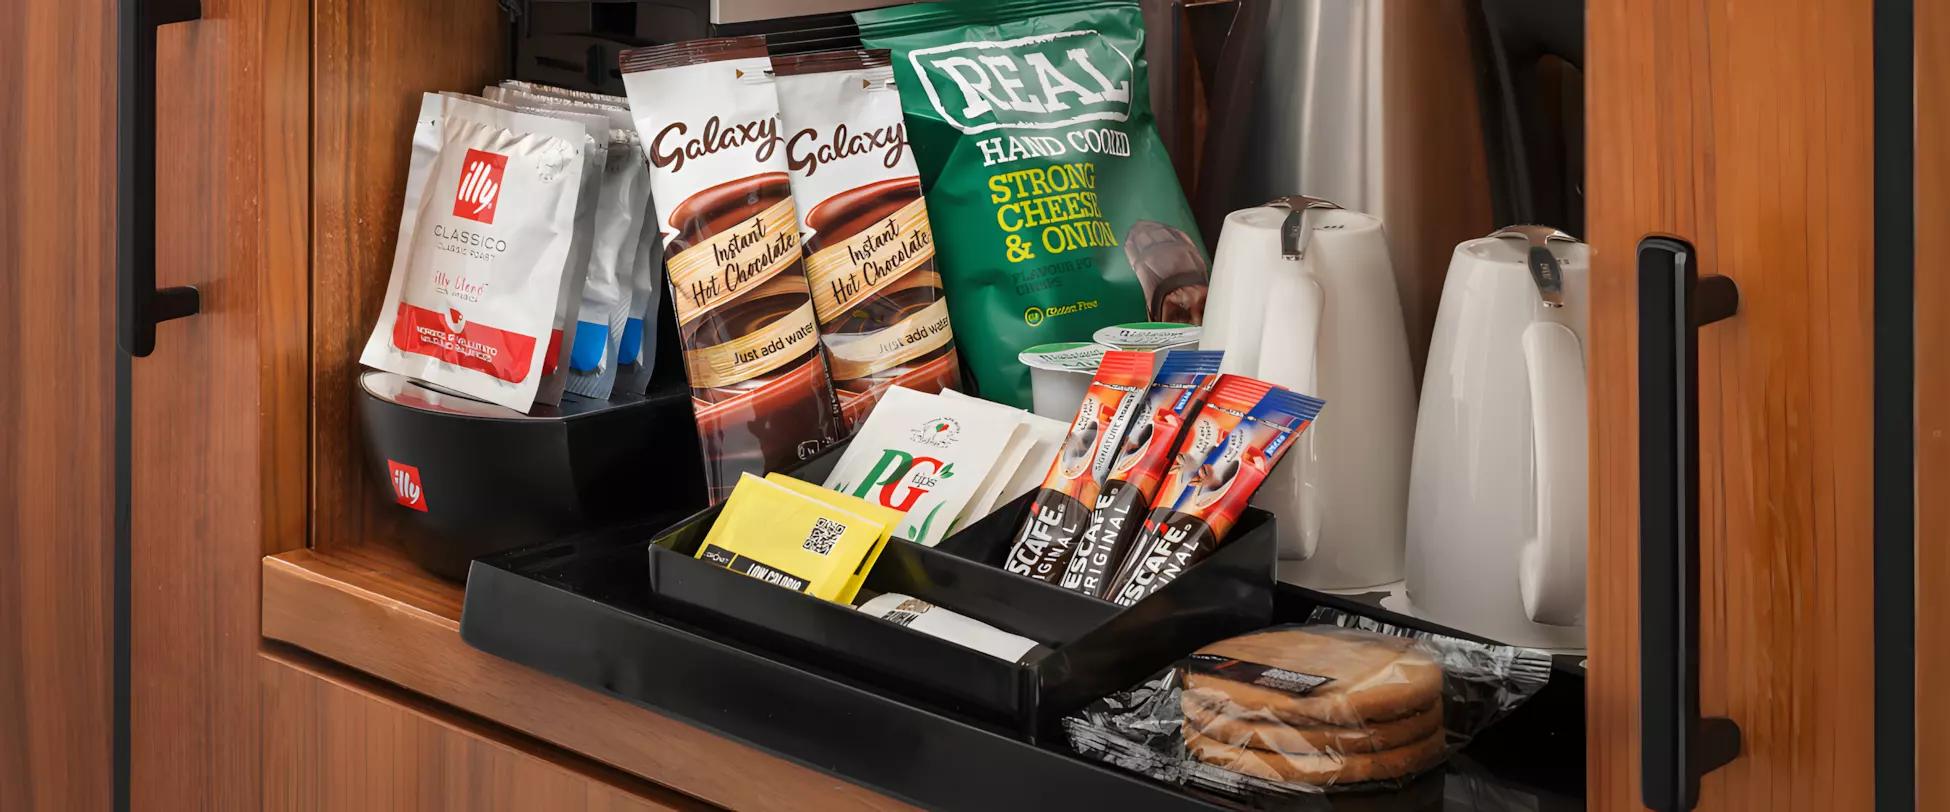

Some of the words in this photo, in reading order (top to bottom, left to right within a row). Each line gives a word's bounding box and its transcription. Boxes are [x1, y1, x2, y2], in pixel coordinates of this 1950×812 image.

[931, 48, 1129, 119] REAL
[650, 115, 785, 173] Galaxy
[786, 123, 910, 177] Galaxy
[976, 136, 1067, 167] HAND
[458, 161, 498, 214] illy
[988, 163, 1096, 204] STRONG
[997, 191, 1102, 232] CHEESE
[434, 225, 507, 252] CLASSICO
[712, 217, 766, 266] Instant
[848, 218, 899, 266] Instant
[1005, 234, 1035, 263] &
[1042, 220, 1119, 254] ONION
[692, 276, 720, 308] Hot
[725, 231, 797, 292] Chocolate
[831, 274, 860, 305] Hot
[863, 229, 931, 286] Chocolate
[734, 349, 758, 365] Just
[761, 338, 785, 356] add
[906, 326, 929, 345] add
[394, 469, 420, 504] illy
[852, 449, 944, 513] PG
[911, 472, 937, 487] tips
[1032, 523, 1077, 580] IGINAL
[1083, 505, 1130, 594] RIGINAL
